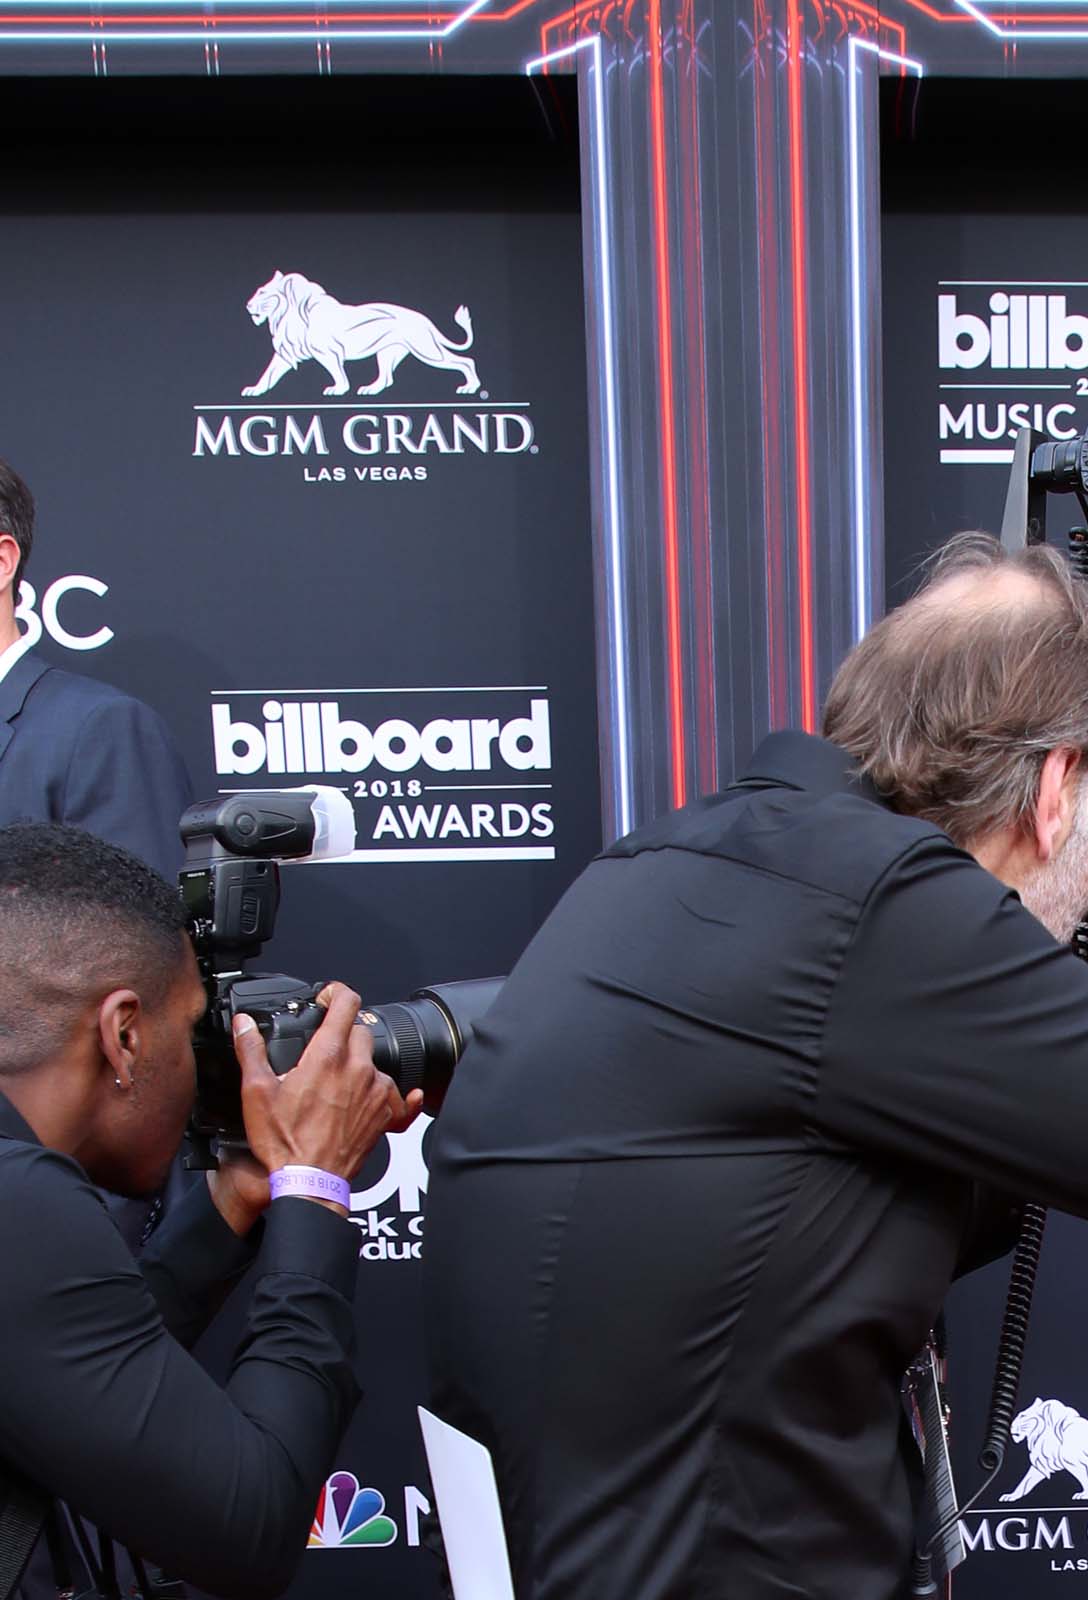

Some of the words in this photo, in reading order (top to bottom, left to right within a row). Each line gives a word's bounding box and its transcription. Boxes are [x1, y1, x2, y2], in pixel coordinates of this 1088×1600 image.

[191, 415, 330, 457] MGM
[342, 412, 533, 454] GRAND
[939, 403, 1078, 440] MUSIC
[303, 467, 347, 482] LAS
[353, 465, 428, 481] VEGAS
[211, 699, 551, 774] billboard
[353, 779, 423, 798] 2018
[372, 803, 555, 838] AWARDS
[958, 1516, 1074, 1551] MGM
[1051, 1559, 1088, 1571] LAS
